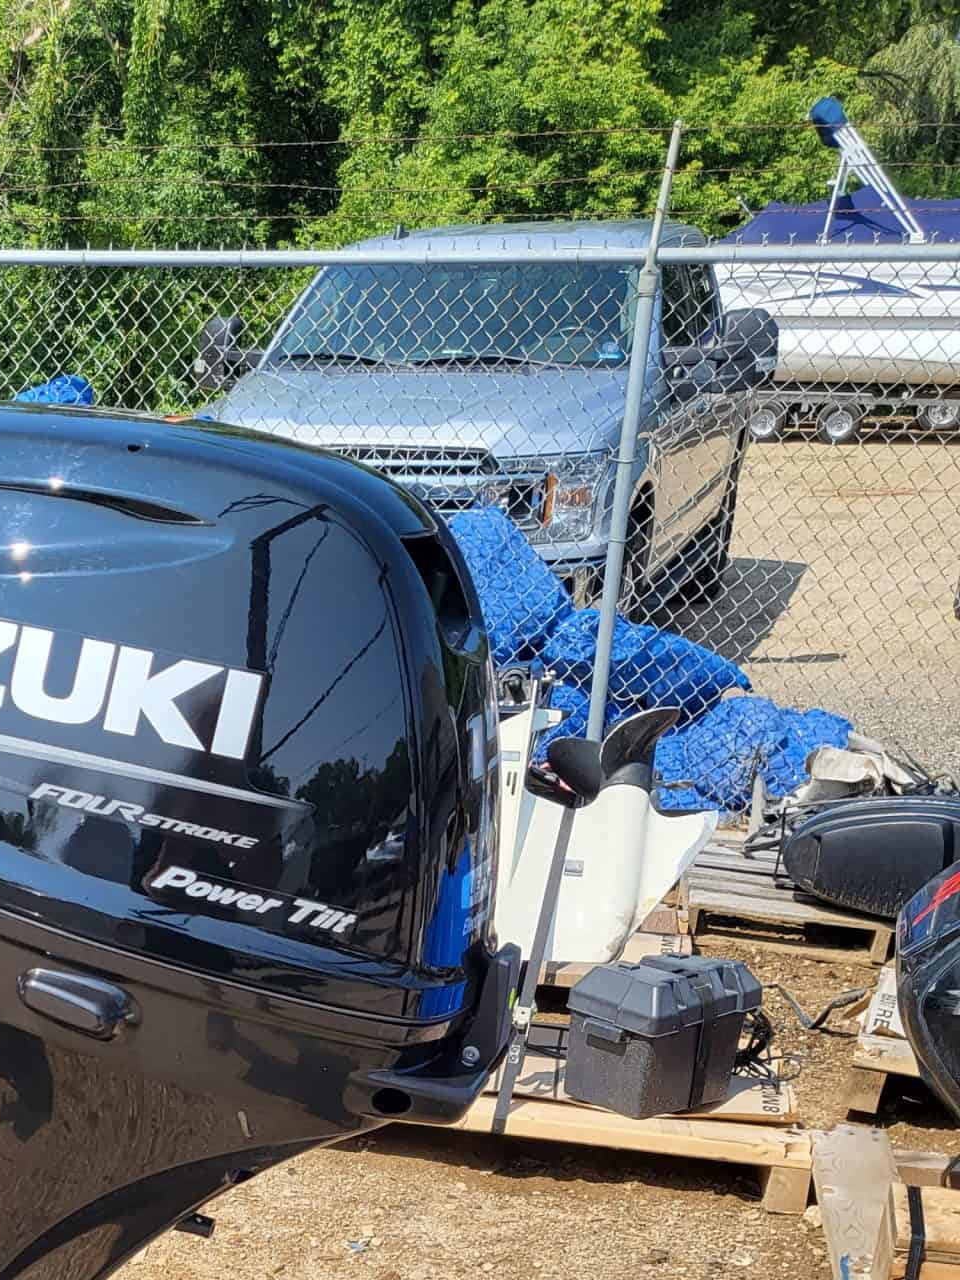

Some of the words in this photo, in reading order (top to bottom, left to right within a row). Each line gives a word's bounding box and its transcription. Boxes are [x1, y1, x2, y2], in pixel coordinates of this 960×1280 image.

[28, 782, 144, 823] FOUR
[139, 814, 259, 849] STROKE
[151, 865, 283, 914] Power
[288, 898, 358, 934] Tilt
